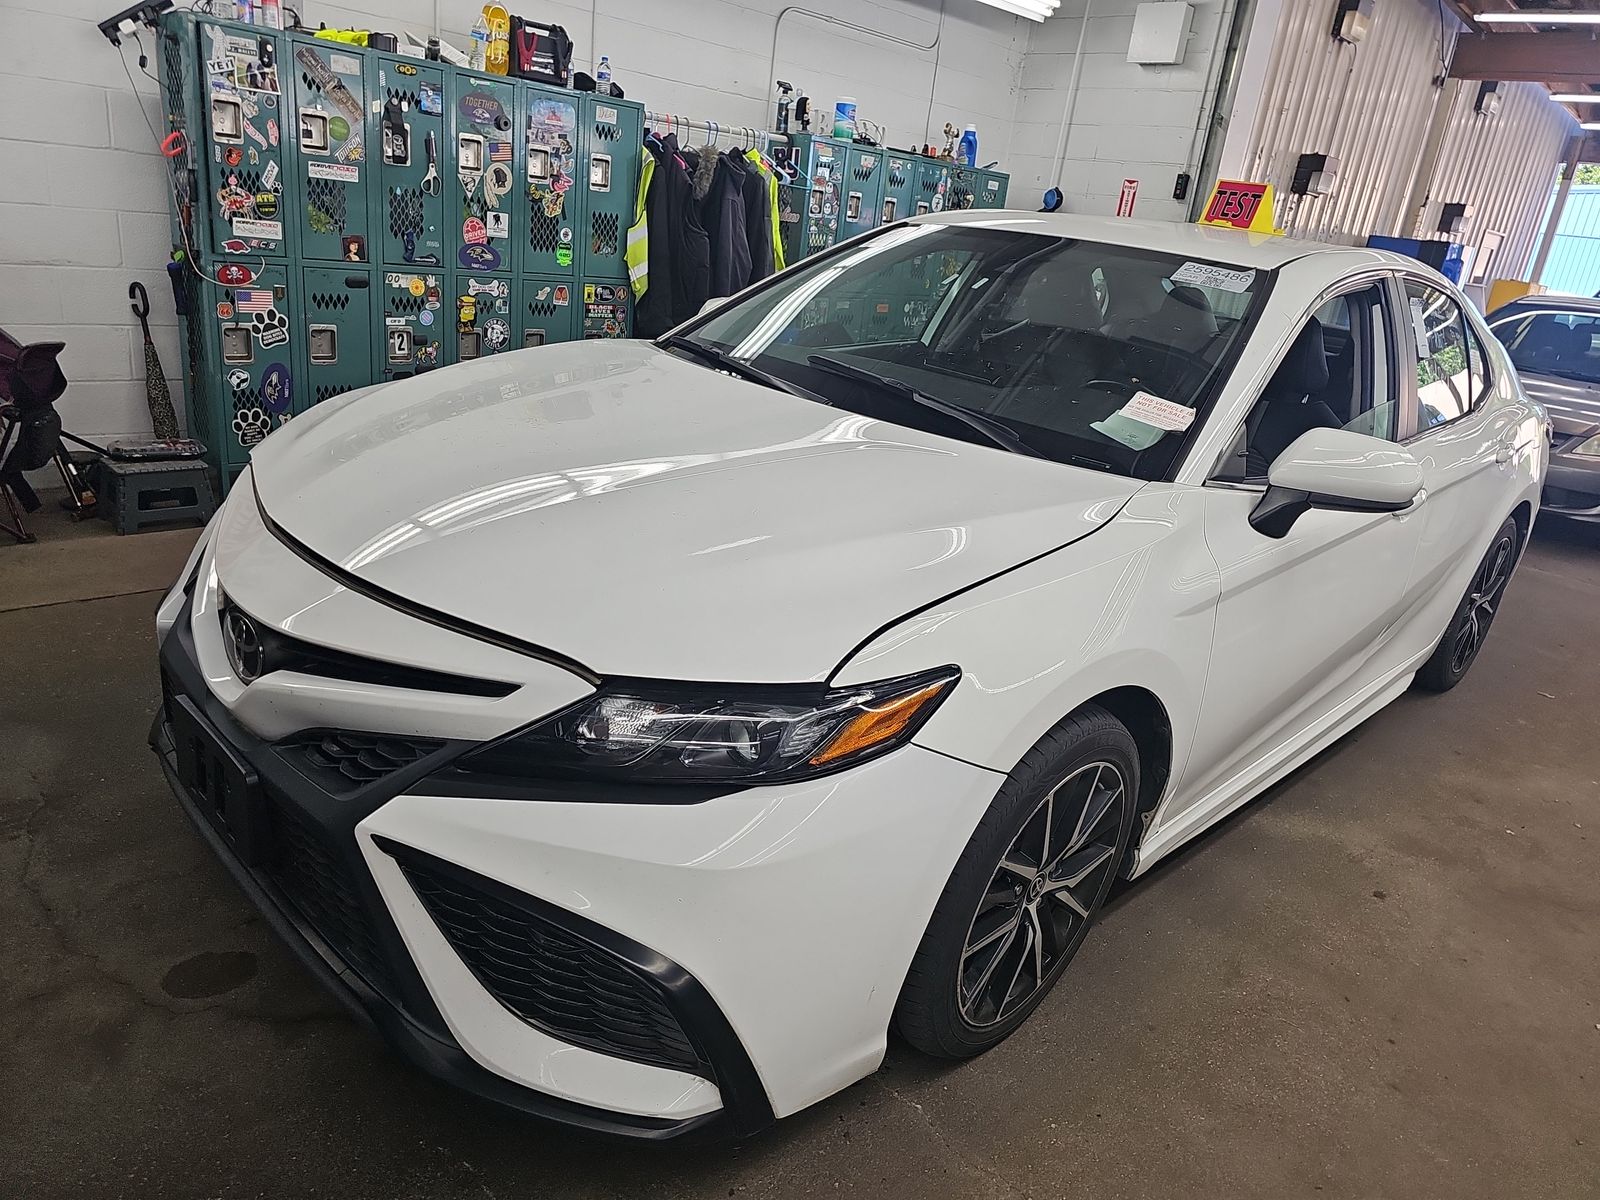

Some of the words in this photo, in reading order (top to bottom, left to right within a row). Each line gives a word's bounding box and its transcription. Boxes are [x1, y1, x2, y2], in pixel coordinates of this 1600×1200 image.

[465, 97, 498, 111] TOGETHER
[256, 194, 275, 203] ATS
[1210, 189, 1263, 221] TEST
[1184, 264, 1251, 283] 2595486
[396, 333, 405, 352] 2
[1136, 400, 1151, 408] NOT
[1152, 405, 1167, 413] FOR
[1168, 410, 1188, 419] SALE
[1138, 395, 1154, 404] THIS
[1155, 400, 1185, 414] VEHICLE
